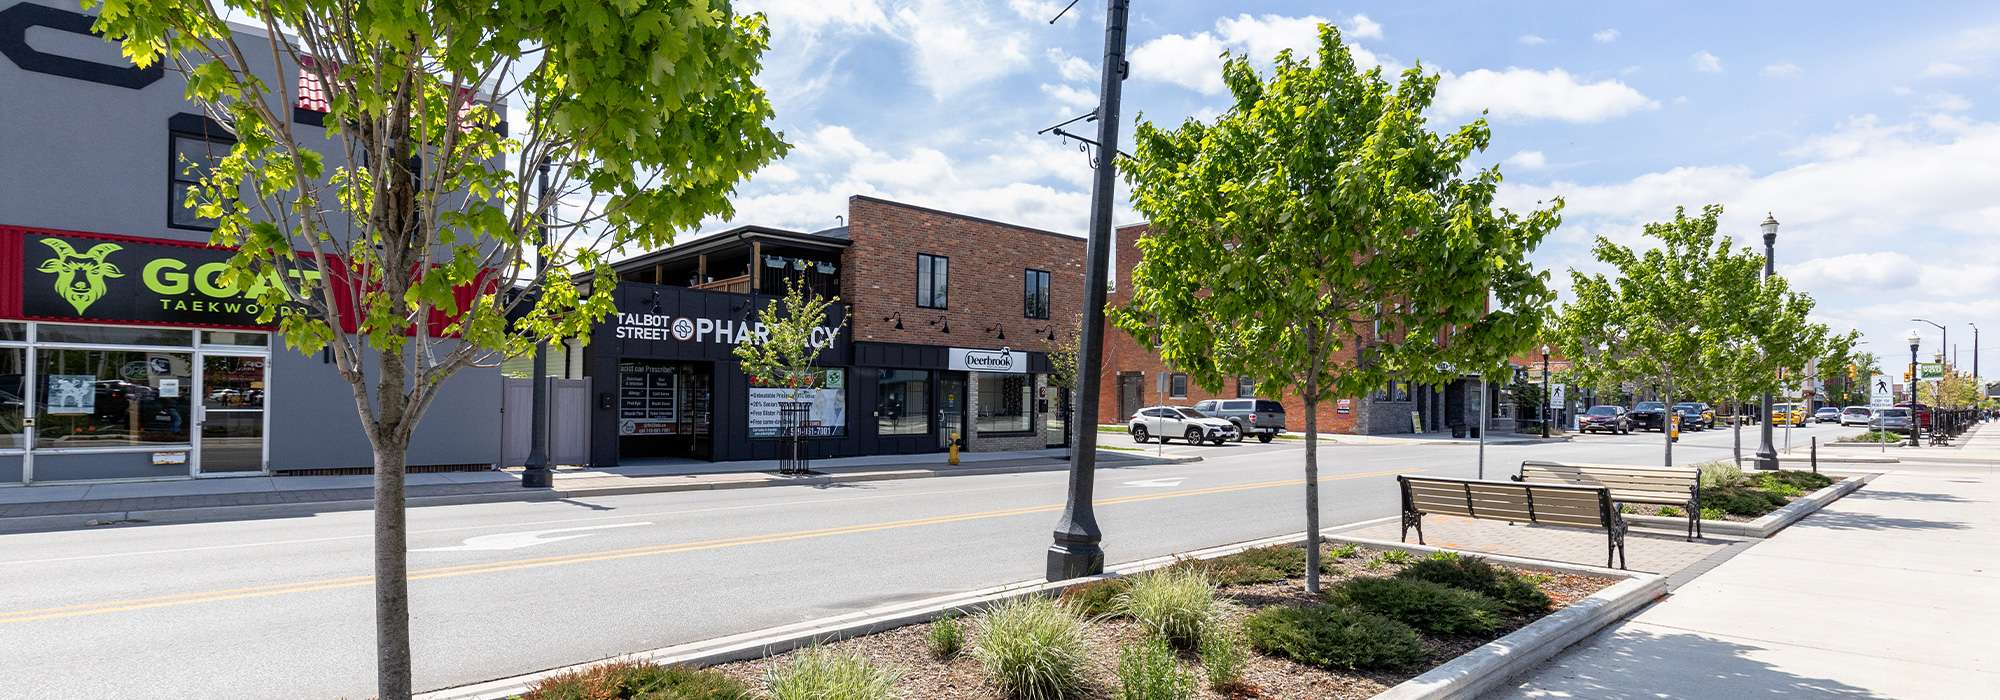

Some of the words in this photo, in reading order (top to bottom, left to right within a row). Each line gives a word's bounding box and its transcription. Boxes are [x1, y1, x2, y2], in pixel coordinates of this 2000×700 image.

[160, 299, 308, 317] TAEKWODO
[617, 312, 670, 327] TALBOT
[616, 326, 670, 341] STREET
[696, 318, 839, 349] PHARCY
[967, 355, 1011, 366] Deerbrook
